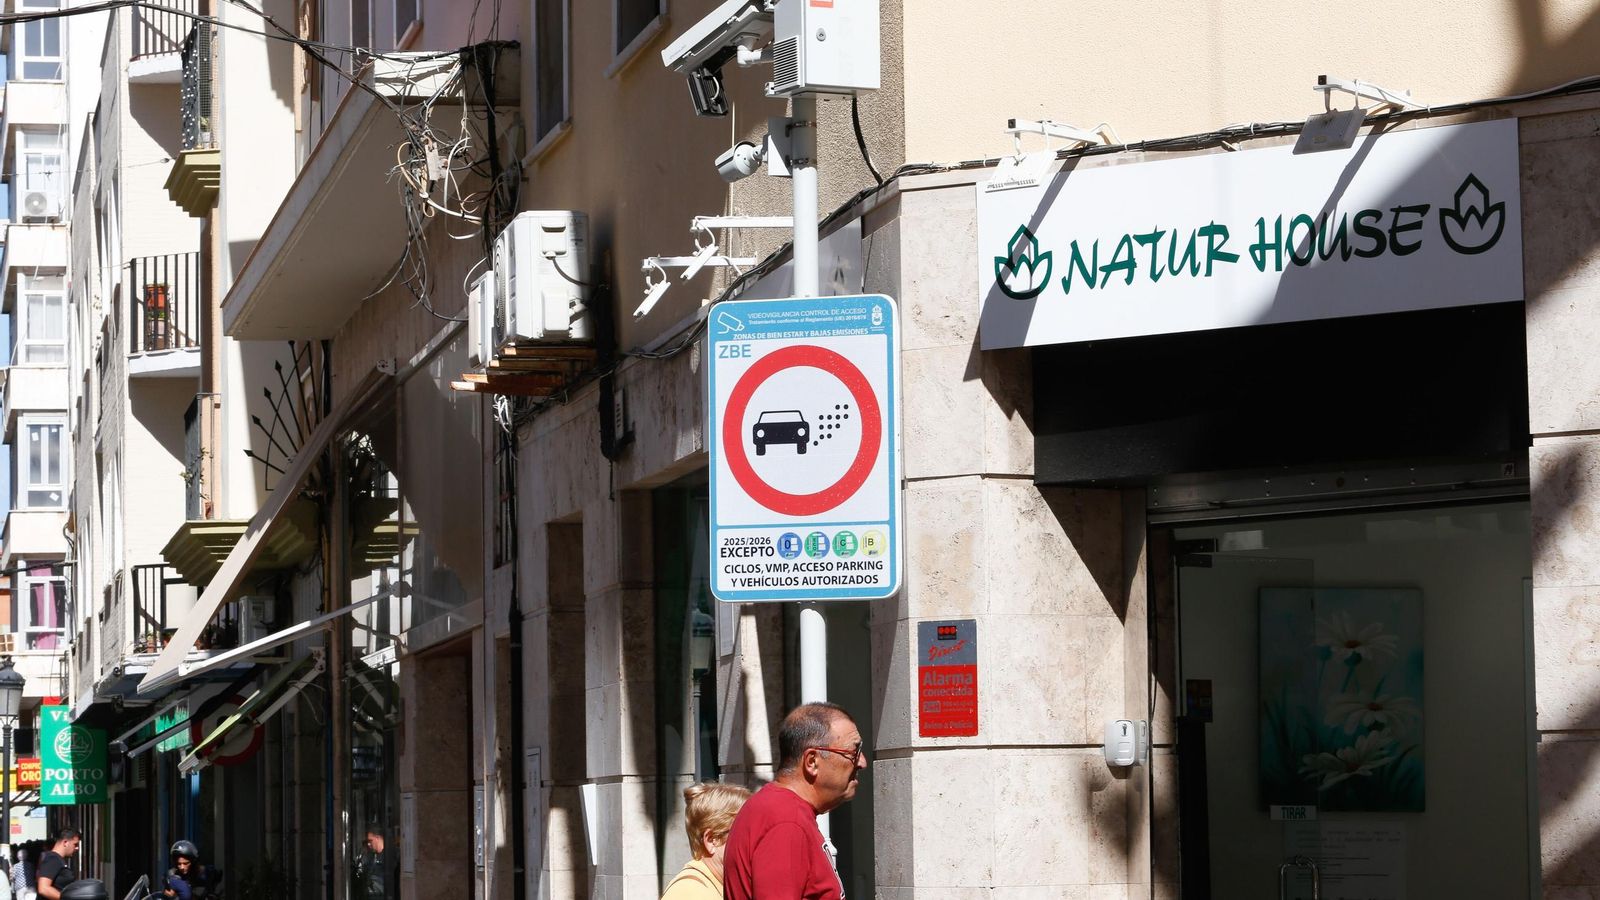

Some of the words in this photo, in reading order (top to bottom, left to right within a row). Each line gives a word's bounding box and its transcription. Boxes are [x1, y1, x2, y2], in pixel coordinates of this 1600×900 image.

[1061, 220, 1240, 295] NATUR
[1249, 203, 1431, 272] HOUSE
[748, 311, 800, 319] VIDEOVIGILANCIA
[801, 309, 830, 317] CONTROL
[841, 307, 867, 315] ACCESO
[767, 331, 782, 339] BIEN
[784, 330, 804, 338] ESTAR
[832, 328, 869, 336] EMISIONES
[718, 343, 752, 359] ZBE
[724, 536, 771, 546] 2025/2026
[840, 539, 847, 547] C
[867, 538, 874, 546] B
[720, 546, 775, 558] EXCEPTO
[724, 563, 764, 574] CICLOS,
[765, 562, 791, 574] VMP,
[792, 561, 834, 572] ACCESO
[836, 560, 883, 571] PARKING
[731, 578, 737, 587] Y
[740, 575, 799, 587] VEHÍCULOS
[802, 574, 879, 585] AUTORIZADOS
[923, 671, 973, 686] Alarma
[923, 685, 973, 697] conectada
[44, 768, 104, 780] PORTO
[50, 783, 97, 796] ALBO
[1281, 806, 1305, 820] TIRAR
